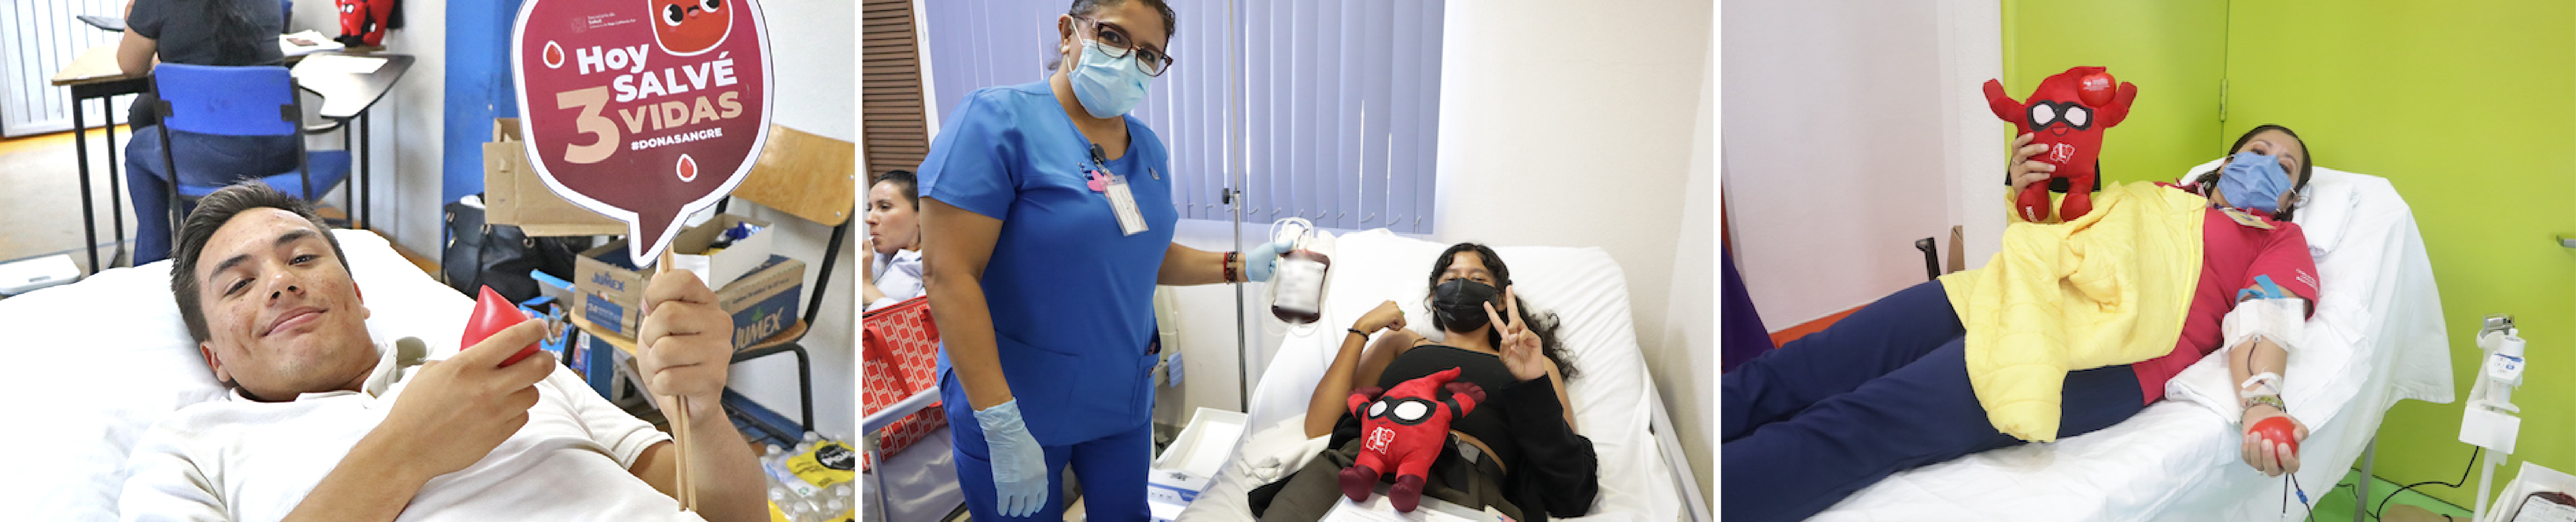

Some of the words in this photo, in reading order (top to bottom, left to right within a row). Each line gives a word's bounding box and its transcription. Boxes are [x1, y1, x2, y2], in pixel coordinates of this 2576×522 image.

[576, 43, 649, 75] Hoy
[613, 51, 738, 102] SALVÉ
[556, 85, 620, 164] 3
[618, 91, 743, 134] VIDAS
[631, 127, 723, 151] #DONASANGRE
[591, 272, 625, 292] JUMEX
[732, 306, 785, 352] JUMEX
